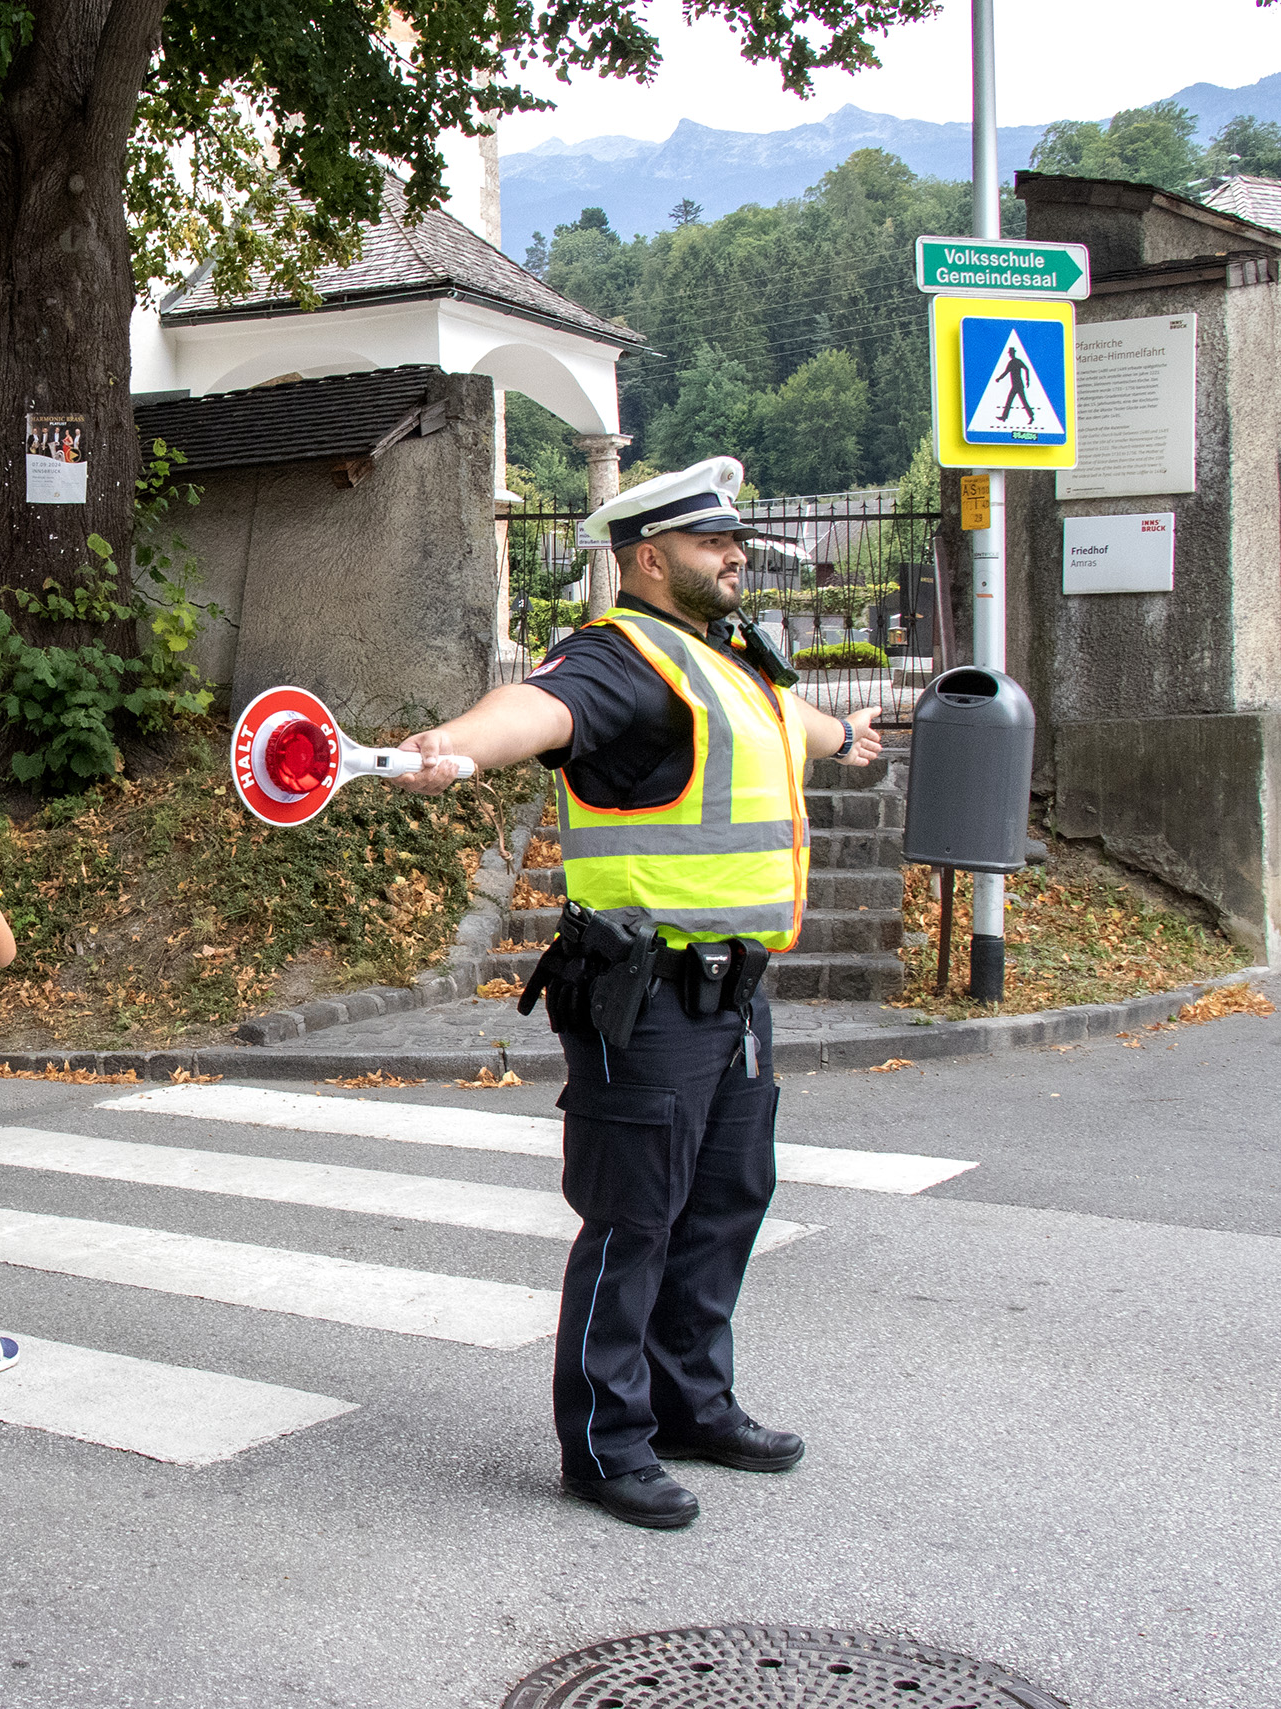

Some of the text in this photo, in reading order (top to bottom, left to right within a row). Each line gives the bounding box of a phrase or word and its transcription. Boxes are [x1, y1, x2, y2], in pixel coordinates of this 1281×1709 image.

[944, 248, 1045, 268] Volksschule
[936, 267, 1057, 287] Gemeindesaal
[1075, 339, 1123, 351] Pfarrkirche
[1071, 545, 1109, 555] Friedhof
[1070, 559, 1097, 568] Amras
[238, 724, 255, 789] HALT
